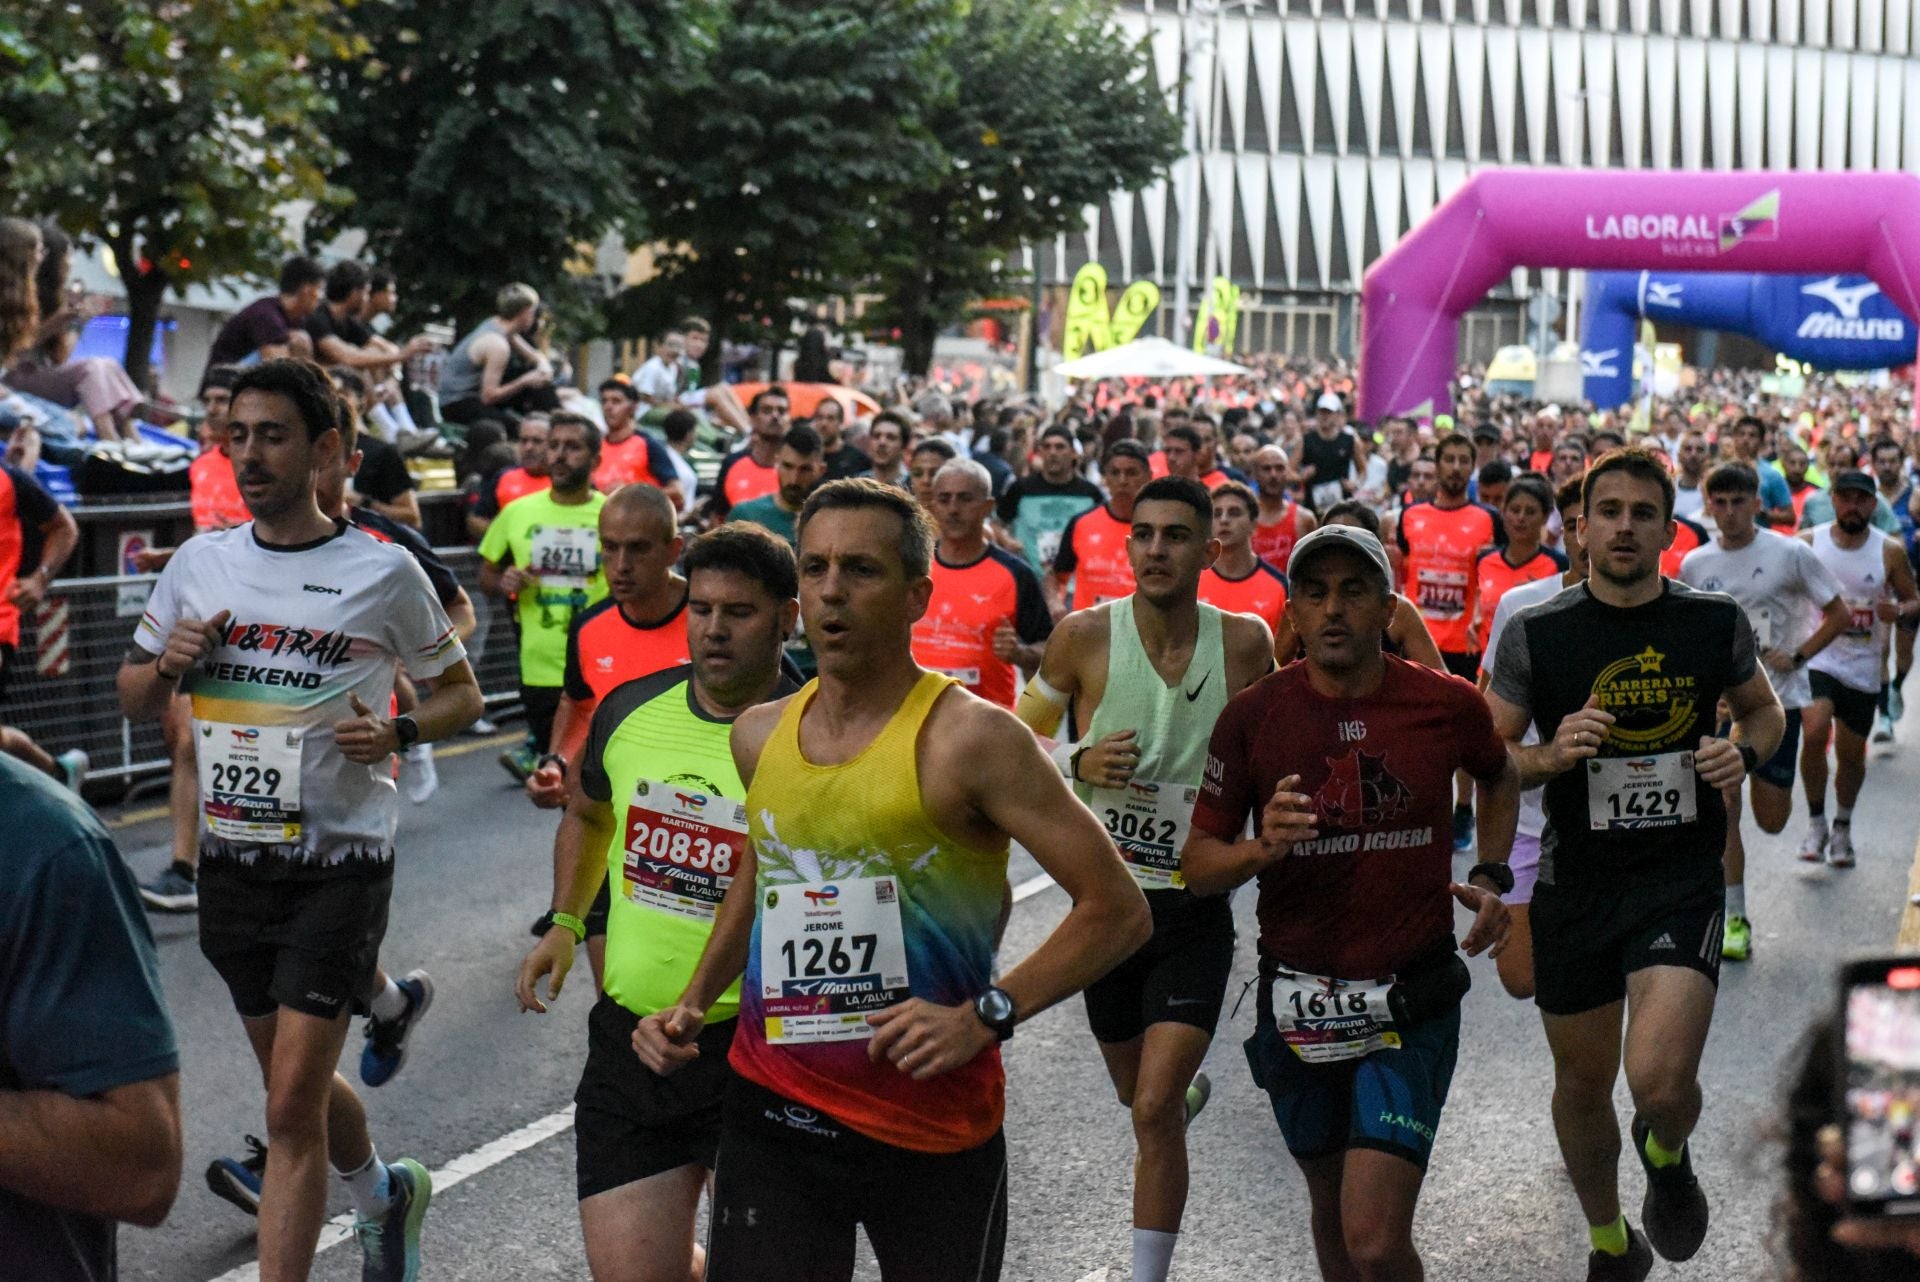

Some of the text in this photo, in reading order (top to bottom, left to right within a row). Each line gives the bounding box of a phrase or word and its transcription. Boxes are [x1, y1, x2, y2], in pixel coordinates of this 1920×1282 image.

[1586, 215, 1716, 239] LABORAL
[541, 547, 584, 563] 2671
[238, 624, 264, 653] &
[271, 625, 354, 670] TRAIL
[204, 661, 322, 689] WEEKEND
[1599, 676, 1695, 692] CARRERA DE
[1600, 689, 1668, 706] REYES
[229, 753, 259, 762] HECTOR
[212, 762, 281, 795] 2929
[1622, 780, 1663, 790] JCERVERO
[1608, 789, 1680, 817] 1429
[661, 816, 710, 833] MARTINTXI
[1105, 808, 1177, 845] 3062
[631, 822, 732, 874] 20838
[1363, 826, 1433, 851] IGOERA
[685, 884, 697, 893] LA
[697, 885, 724, 898] SALVE
[803, 922, 844, 932] JEROME
[782, 934, 877, 978] 1267
[845, 991, 894, 1006] LA SALVE
[1289, 990, 1367, 1018] 1618
[1346, 1028, 1358, 1036] LA
[786, 1119, 840, 1139] SPORT
